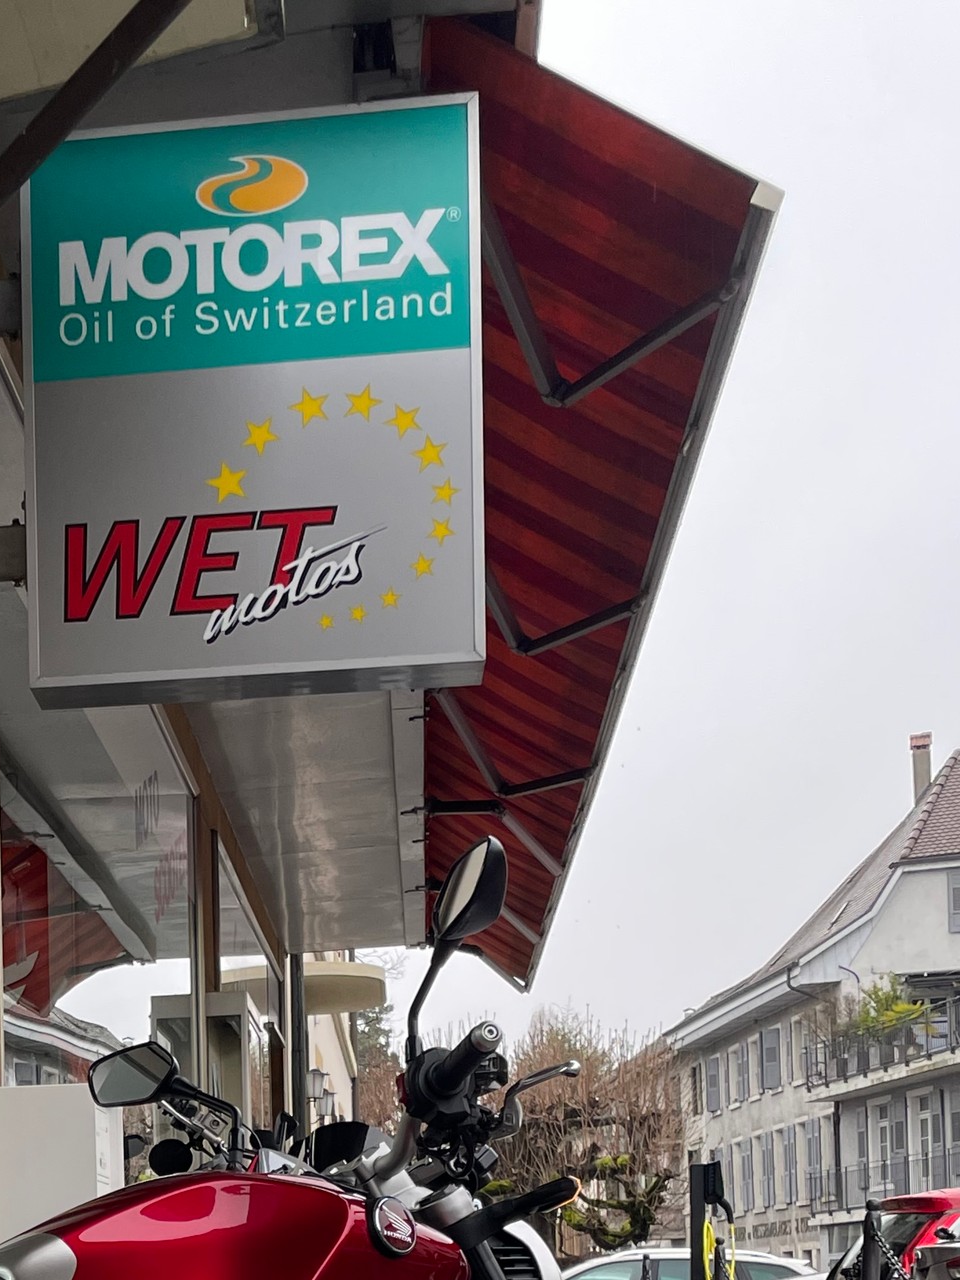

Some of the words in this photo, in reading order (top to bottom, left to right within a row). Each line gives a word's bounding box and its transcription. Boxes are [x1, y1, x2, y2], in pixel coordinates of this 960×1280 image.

[59, 310, 114, 346] Oil
[135, 305, 176, 340] of
[195, 282, 453, 335] Switzerland
[63, 505, 339, 624] WET
[203, 523, 388, 644] motos
[384, 1230, 412, 1244] HONDA
